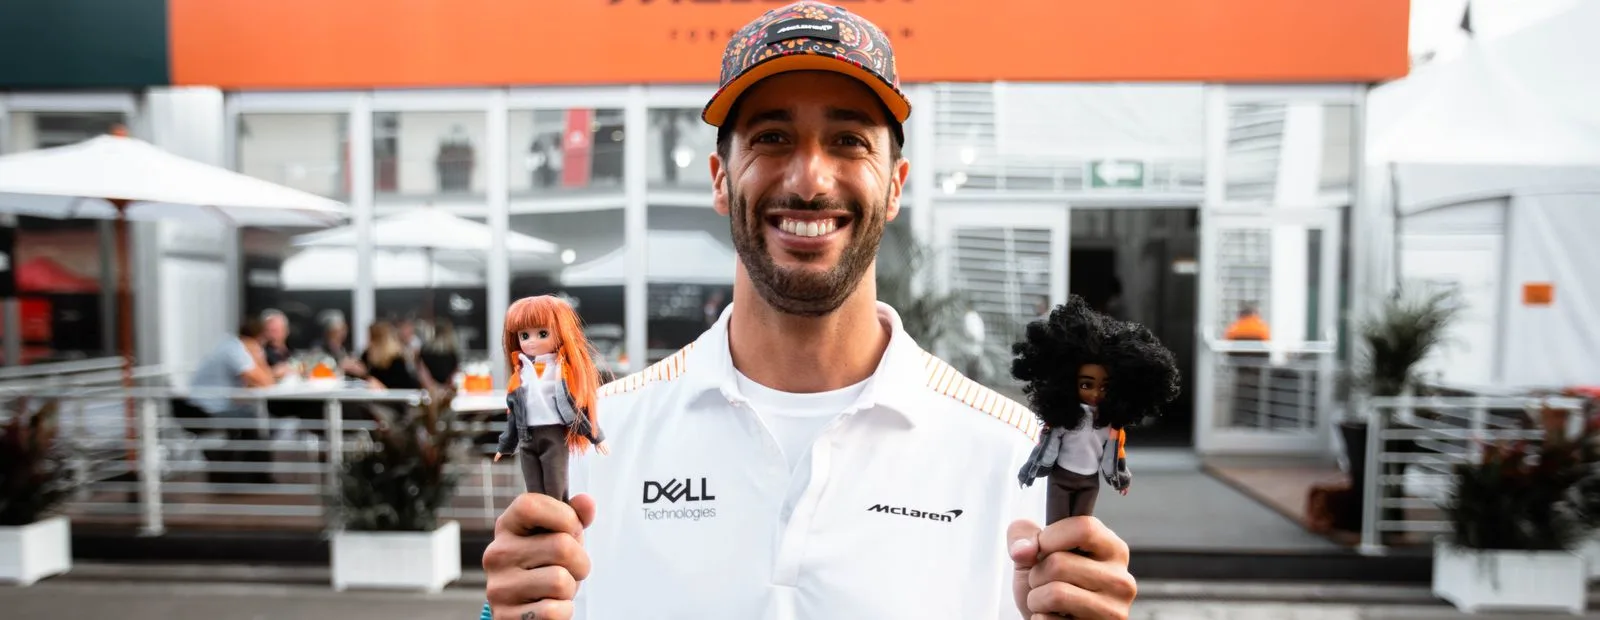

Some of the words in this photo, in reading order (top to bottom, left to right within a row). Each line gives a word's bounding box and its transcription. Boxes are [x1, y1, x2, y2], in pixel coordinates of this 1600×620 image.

[642, 477, 716, 504] DELL
[642, 507, 717, 521] Technologies
[867, 503, 953, 523] McLaren
